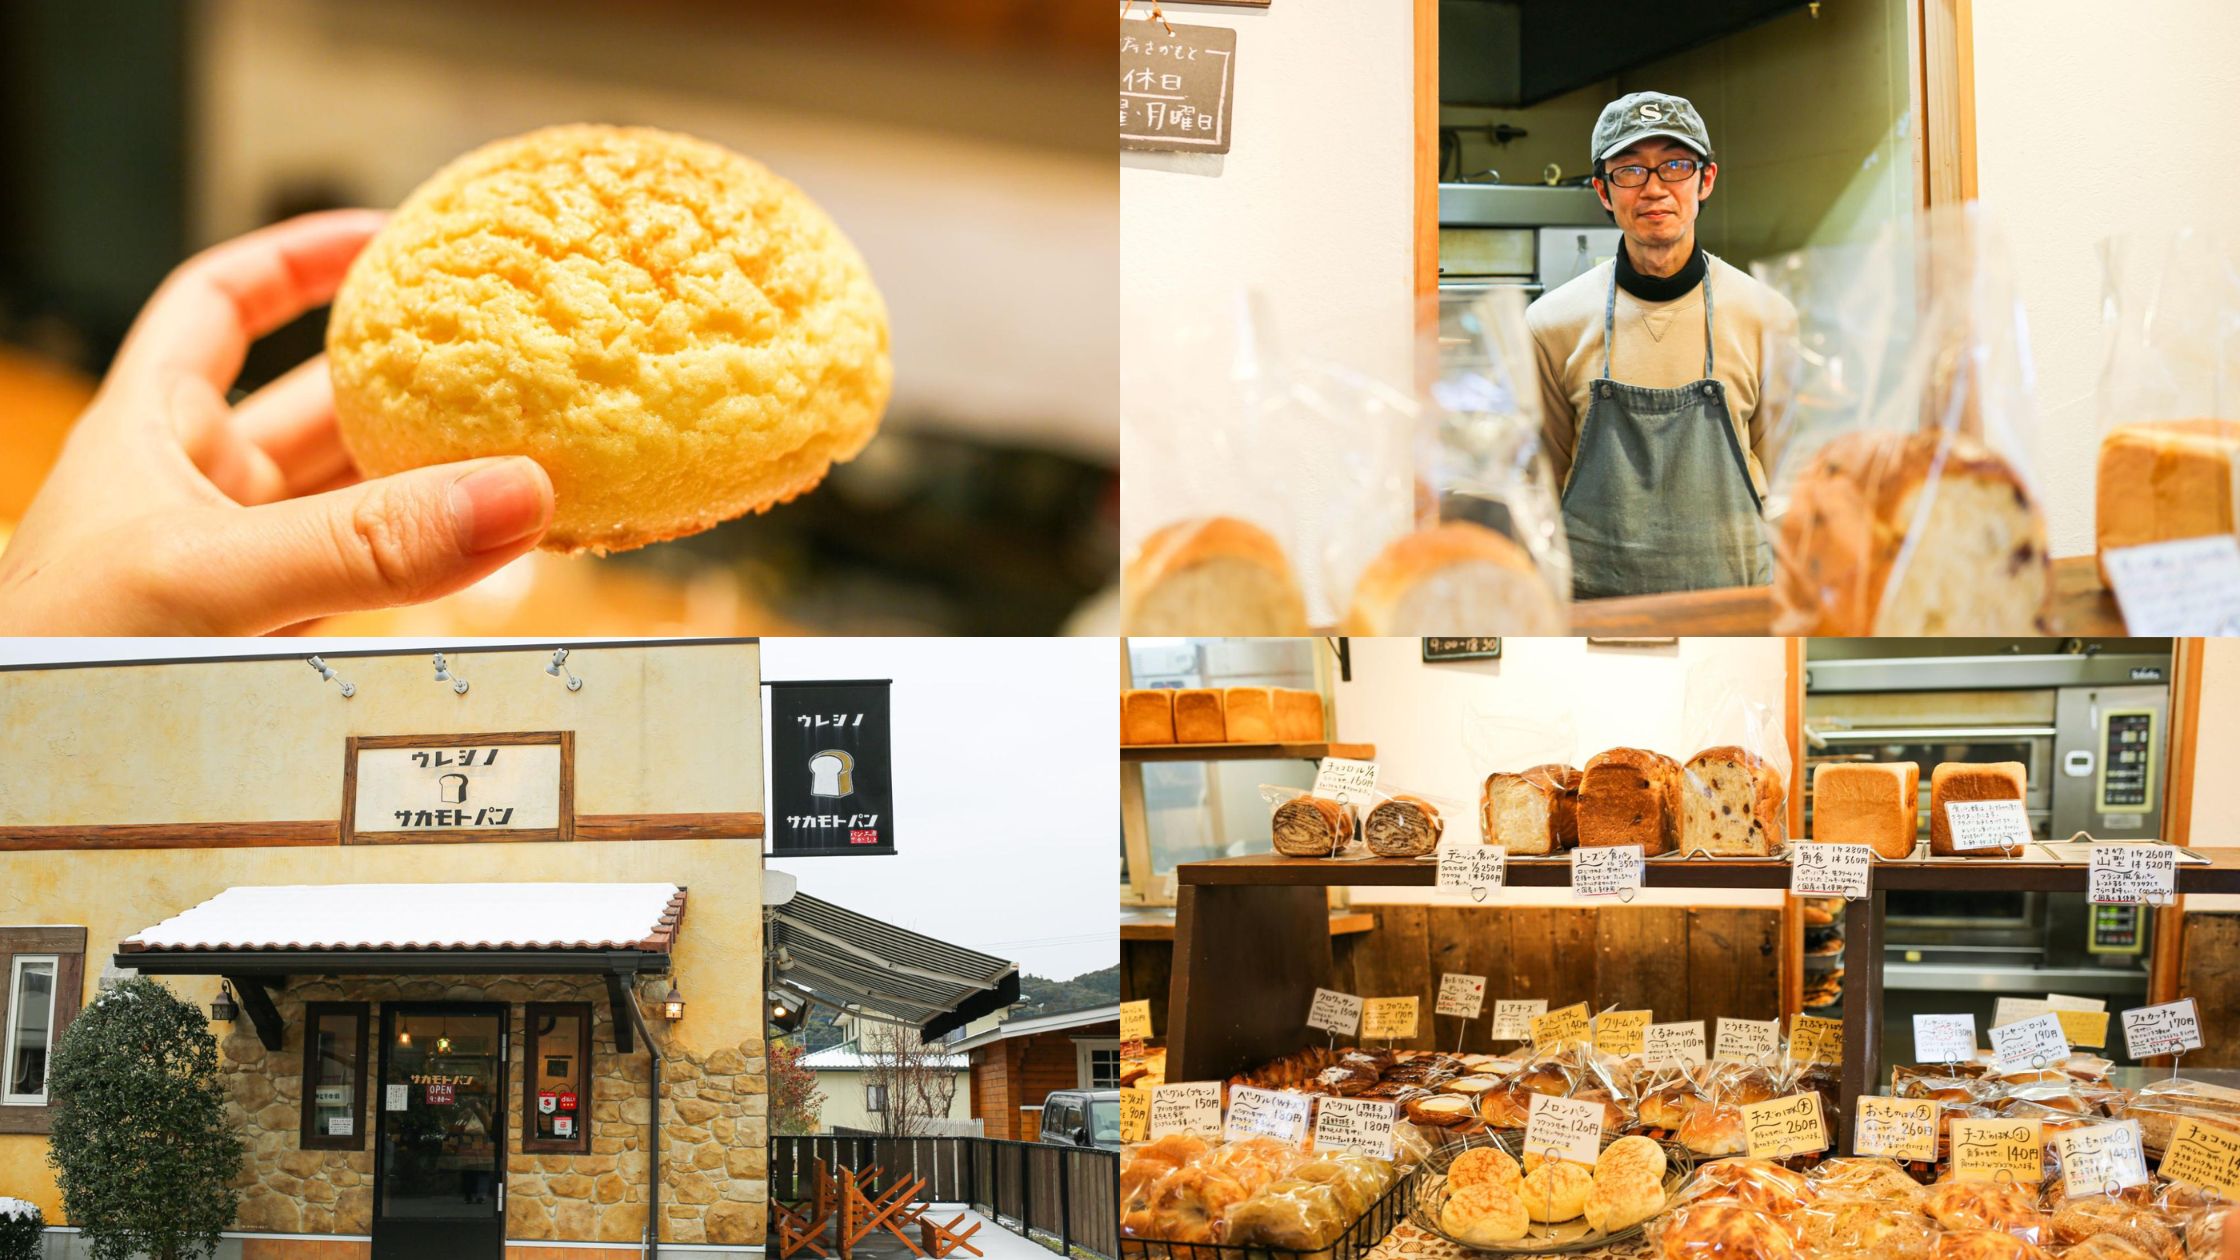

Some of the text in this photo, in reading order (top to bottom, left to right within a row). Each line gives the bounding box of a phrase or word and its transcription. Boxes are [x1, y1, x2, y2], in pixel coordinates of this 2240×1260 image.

[1640, 103, 1662, 122] S
[797, 713, 864, 728] ウレシノ
[411, 748, 499, 768] ウレシノ
[394, 806, 514, 827] サカモトパン
[786, 813, 878, 828] サカモトパン
[1845, 856, 1868, 864] 560円
[2146, 850, 2172, 858] 260円
[1482, 864, 1502, 872] 250円
[2097, 856, 2124, 867] 山型
[2146, 860, 2172, 870] 520円
[1480, 872, 1500, 882] 500円
[2130, 1010, 2176, 1024] フォカッチャ
[2169, 1018, 2194, 1028] 170円
[1626, 1030, 1644, 1041] 140
[2034, 1030, 2058, 1042] 190円
[1682, 1038, 1704, 1048] 100円
[429, 1084, 452, 1094] OPEN
[1196, 1098, 1218, 1109] 150円
[1539, 1098, 1593, 1118] メロンパン
[1364, 1120, 1390, 1134] 180円
[1572, 1120, 1598, 1136] 120円
[1786, 1119, 1818, 1134] 260円
[1902, 1122, 1932, 1136] 260円
[2008, 1146, 2038, 1162] 140円
